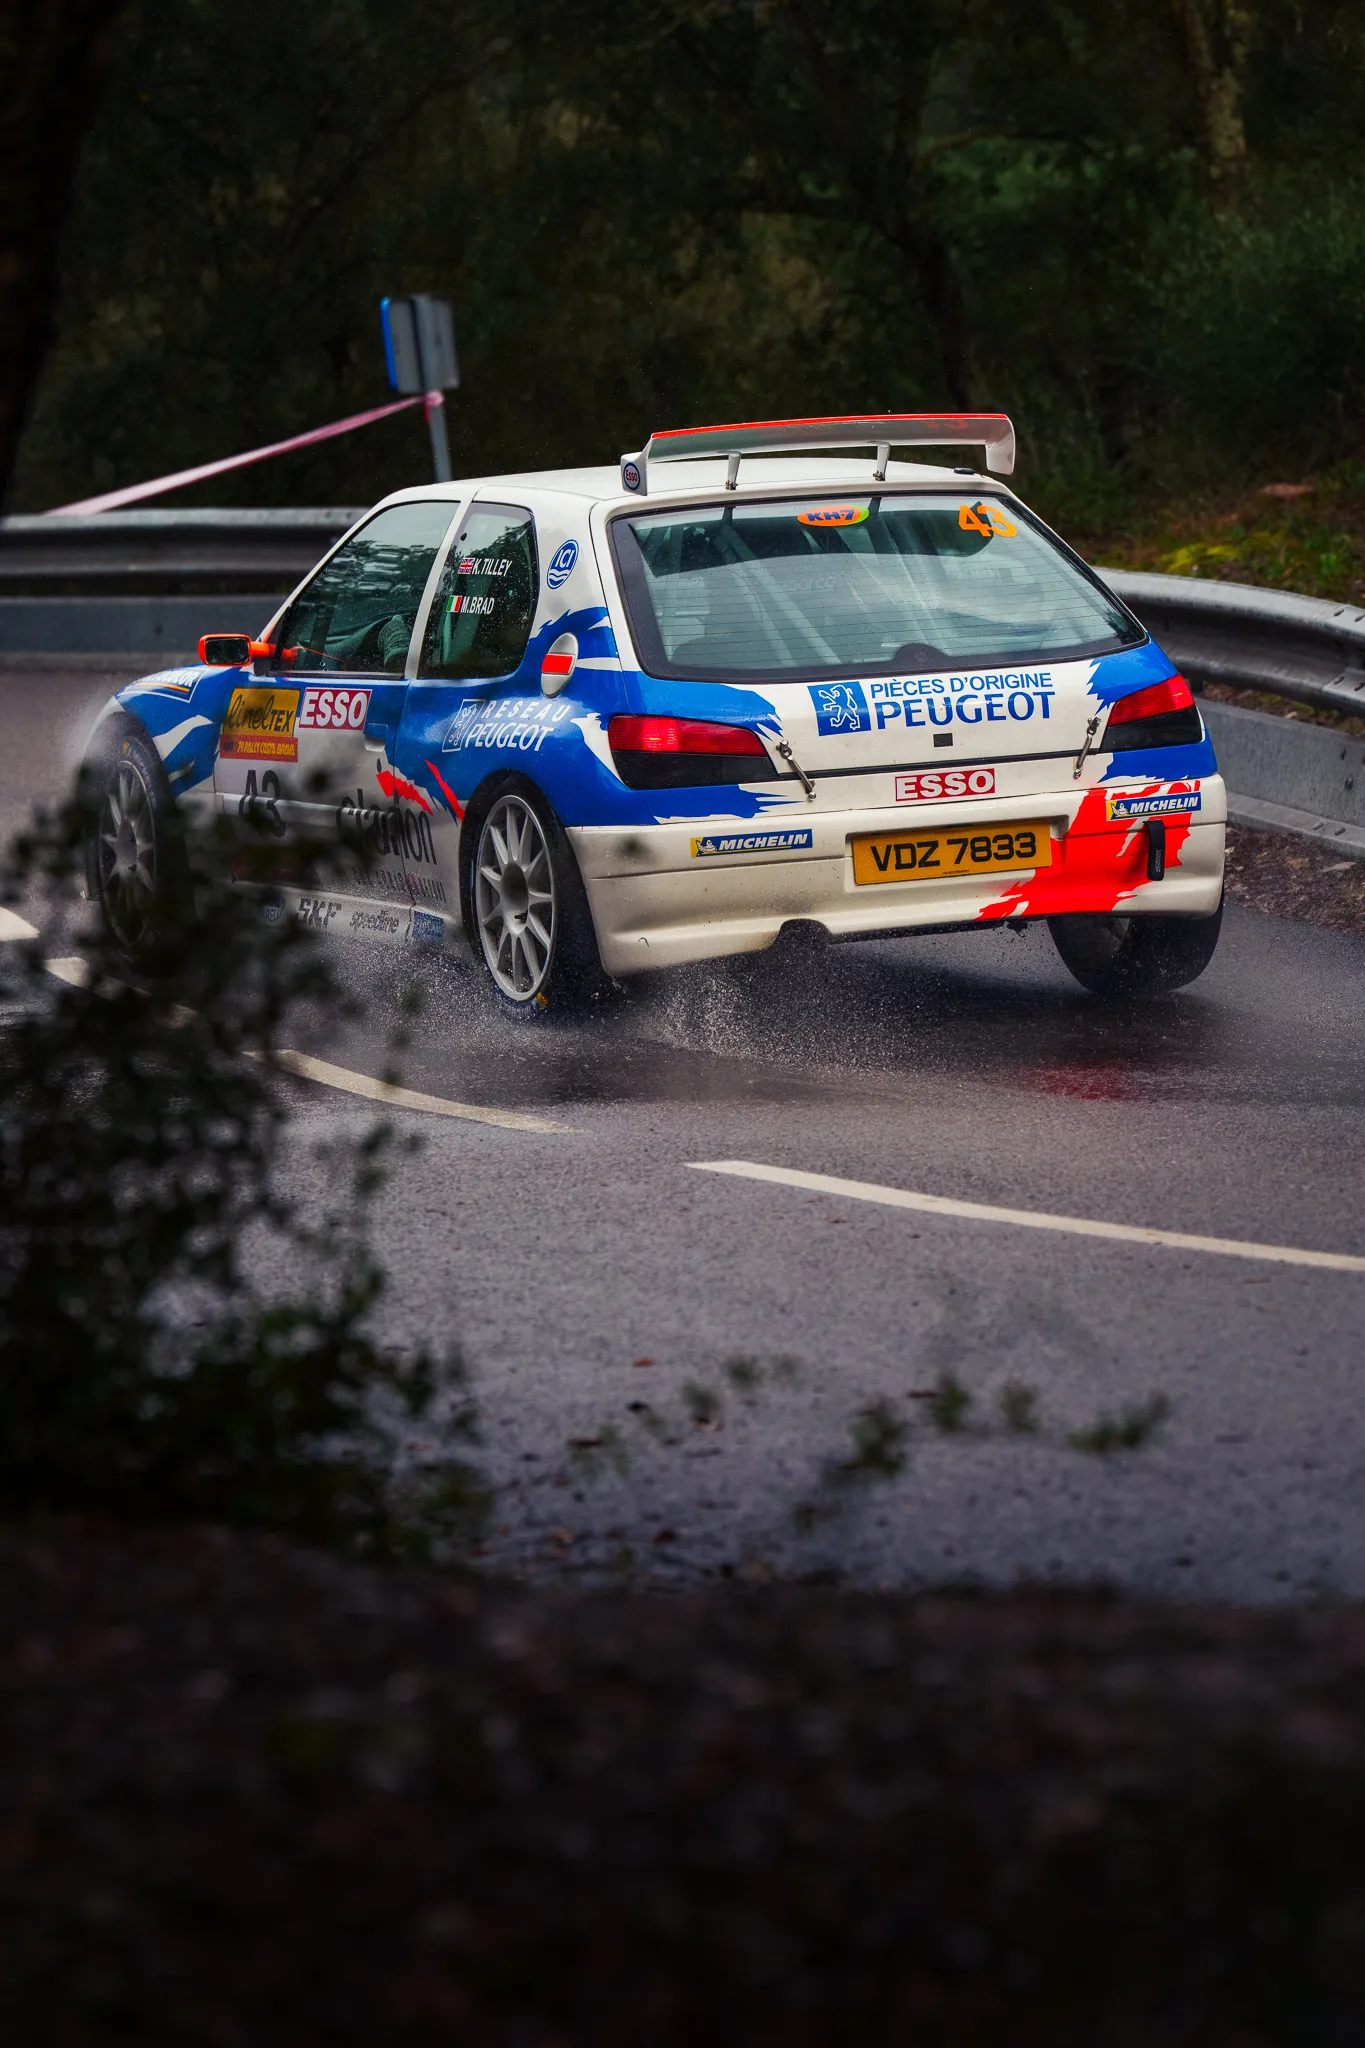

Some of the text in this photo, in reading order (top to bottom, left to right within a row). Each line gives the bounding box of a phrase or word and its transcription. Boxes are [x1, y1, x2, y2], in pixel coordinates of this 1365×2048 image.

[625, 470, 638, 482] Esso
[958, 501, 1017, 538] 43
[472, 558, 512, 577] K.TILLEY
[556, 548, 575, 568] ICI
[461, 596, 495, 615] M.BRAD
[870, 676, 945, 698] PIÈCES
[300, 691, 367, 727] ESSO
[482, 701, 570, 722] RESEAU
[873, 691, 1056, 730] PEUGEOT
[464, 723, 555, 751] PEUGEOT
[896, 770, 995, 800] ESSO
[1129, 796, 1199, 813] MICHELIN
[718, 833, 808, 850] MICHELIN
[871, 832, 1037, 872] VDZ 7833
[297, 898, 342, 930] SKF
